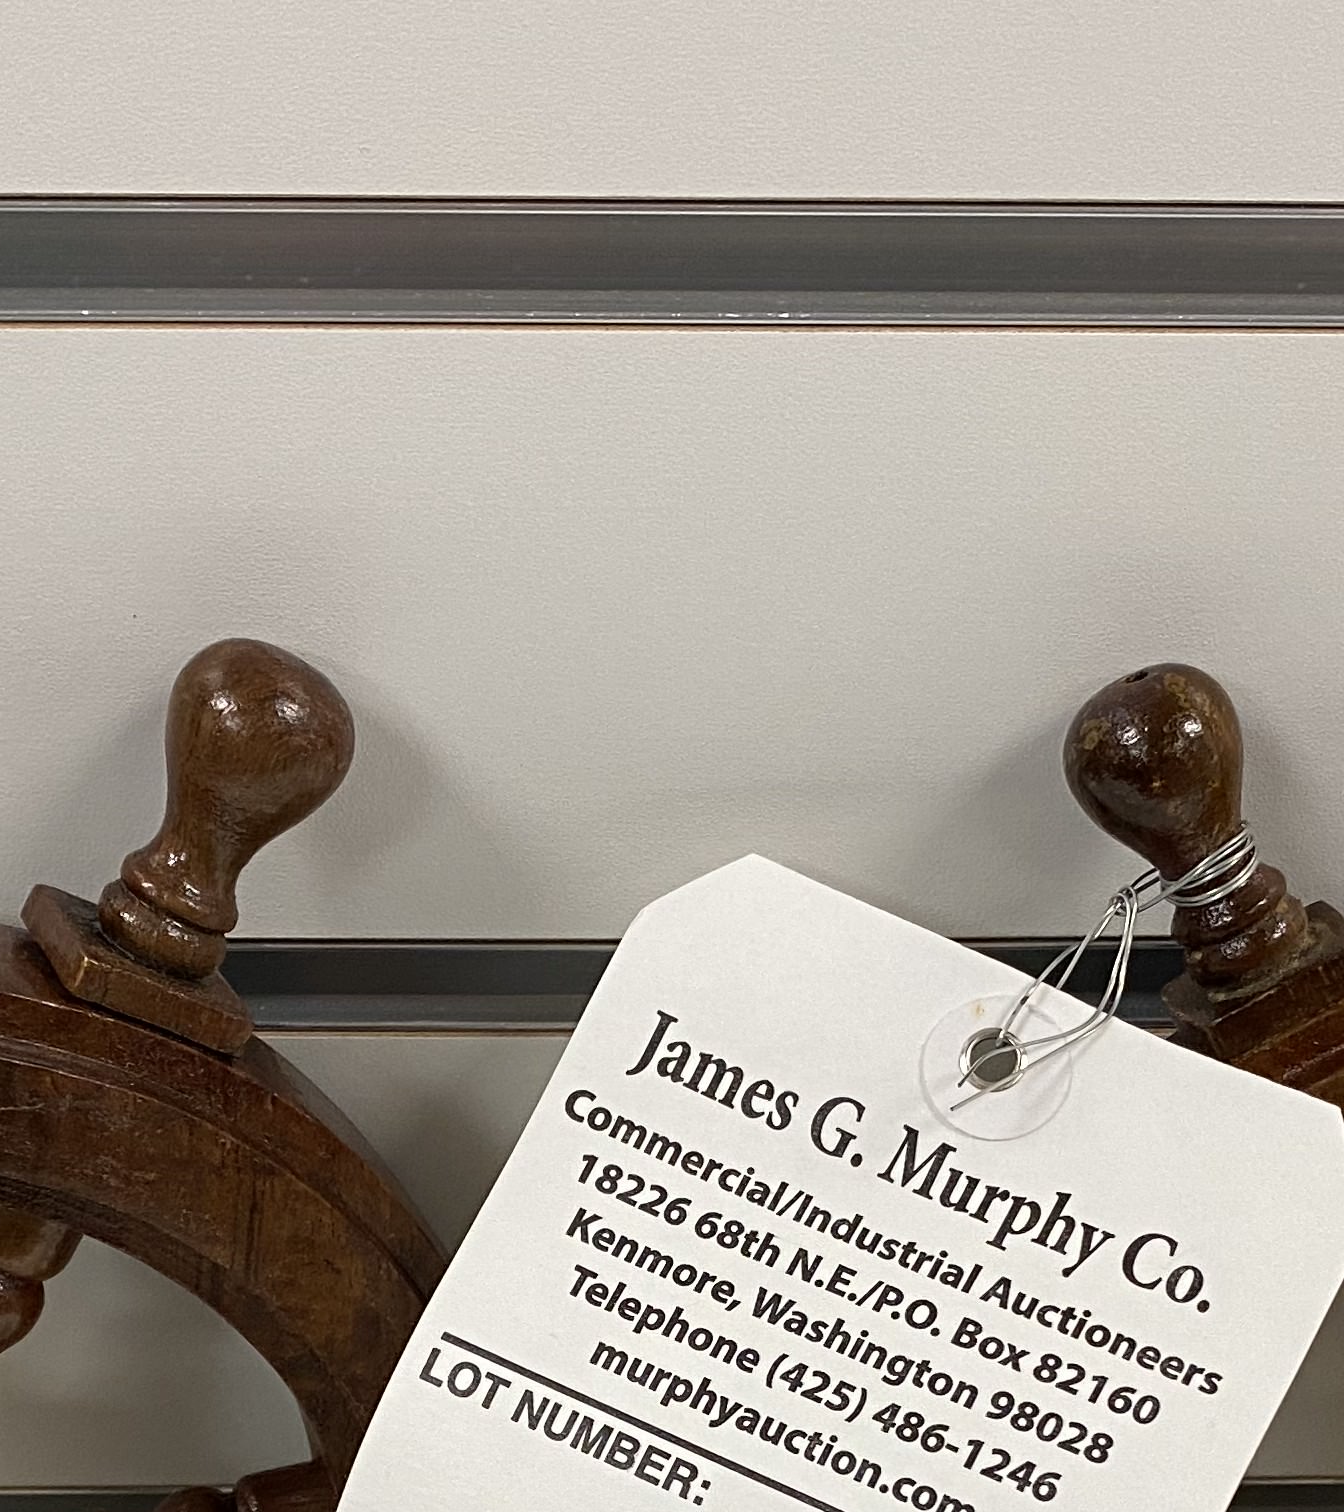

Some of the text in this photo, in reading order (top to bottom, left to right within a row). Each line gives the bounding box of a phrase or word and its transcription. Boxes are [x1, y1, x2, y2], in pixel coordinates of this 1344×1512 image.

[564, 1089, 1223, 1395] Commercial/Industrial Auctioneers
[578, 1154, 1161, 1425] 18226 68th N.E./P.O. Box 82160
[625, 1009, 1210, 1313] James G. Murphy Co.
[419, 1347, 711, 1506] LOT NUMBER:
[566, 1207, 1114, 1464] Kenmore, Washington 98028
[569, 1264, 1063, 1502] Telephone (425) 486-1246
